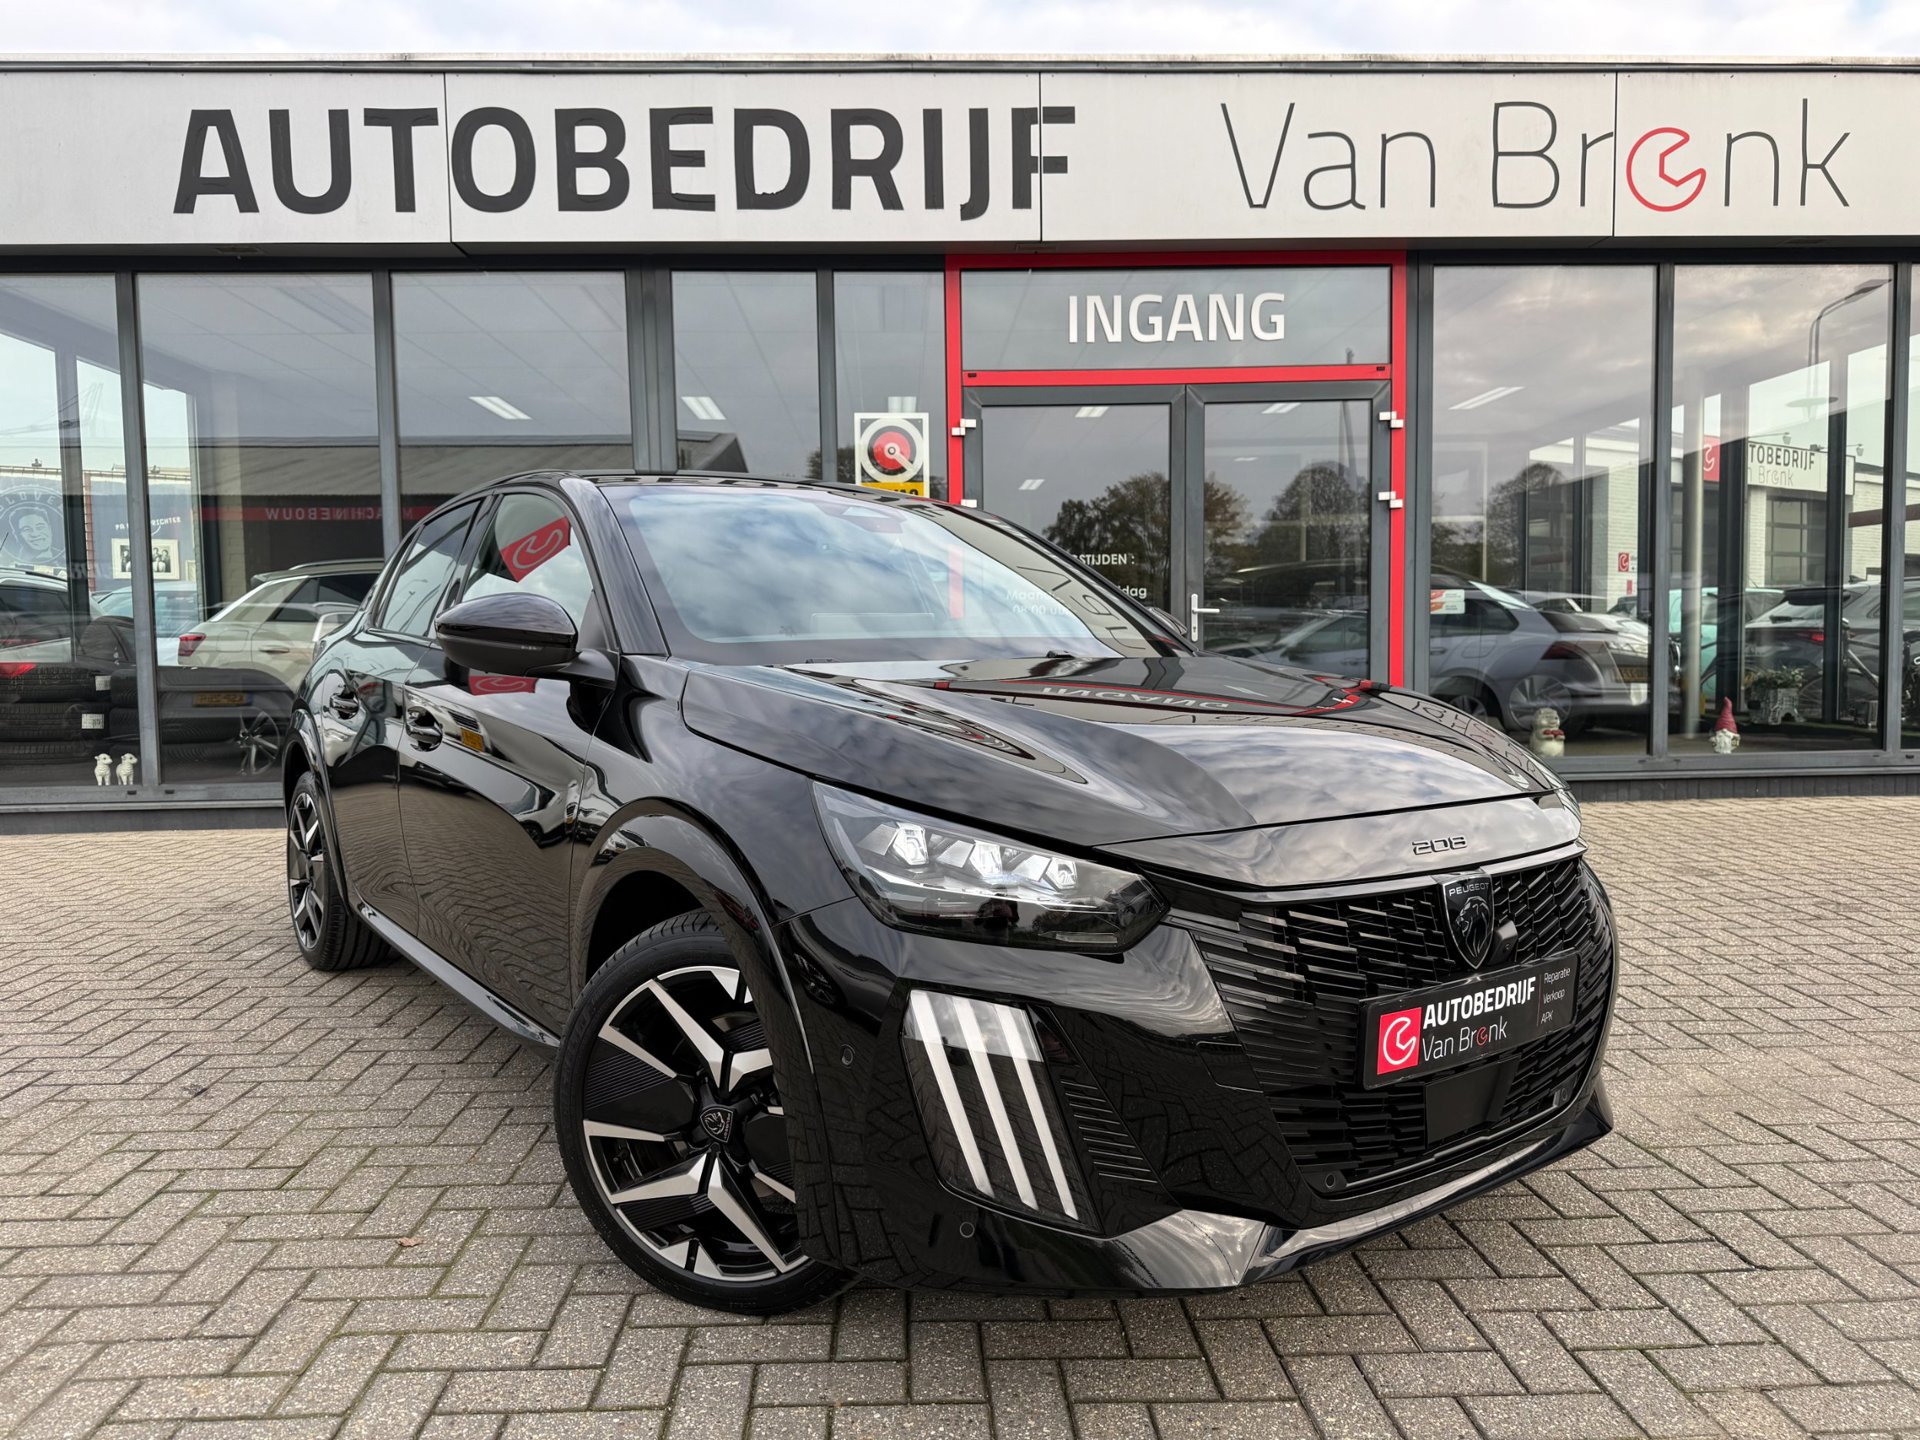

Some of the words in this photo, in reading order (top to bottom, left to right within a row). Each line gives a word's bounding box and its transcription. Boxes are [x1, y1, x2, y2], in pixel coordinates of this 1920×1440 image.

[173, 107, 1075, 221] AUTOBEDRIJF
[1220, 102, 1435, 210] Van
[1068, 292, 1285, 343] INGANG
[1749, 444, 1815, 471] TOBEDRIJF
[1074, 553, 1127, 565] STIJDEN
[1118, 585, 1147, 599] dag
[1412, 836, 1467, 855] 208
[1449, 882, 1489, 896] PEUGEOT
[1544, 967, 1571, 984] Reparatie
[1423, 977, 1536, 1029] AUTOBEDRIJF
[1543, 989, 1565, 1004] Verkoop
[1540, 1010, 1554, 1024] APK
[1422, 1036, 1454, 1061] Van
